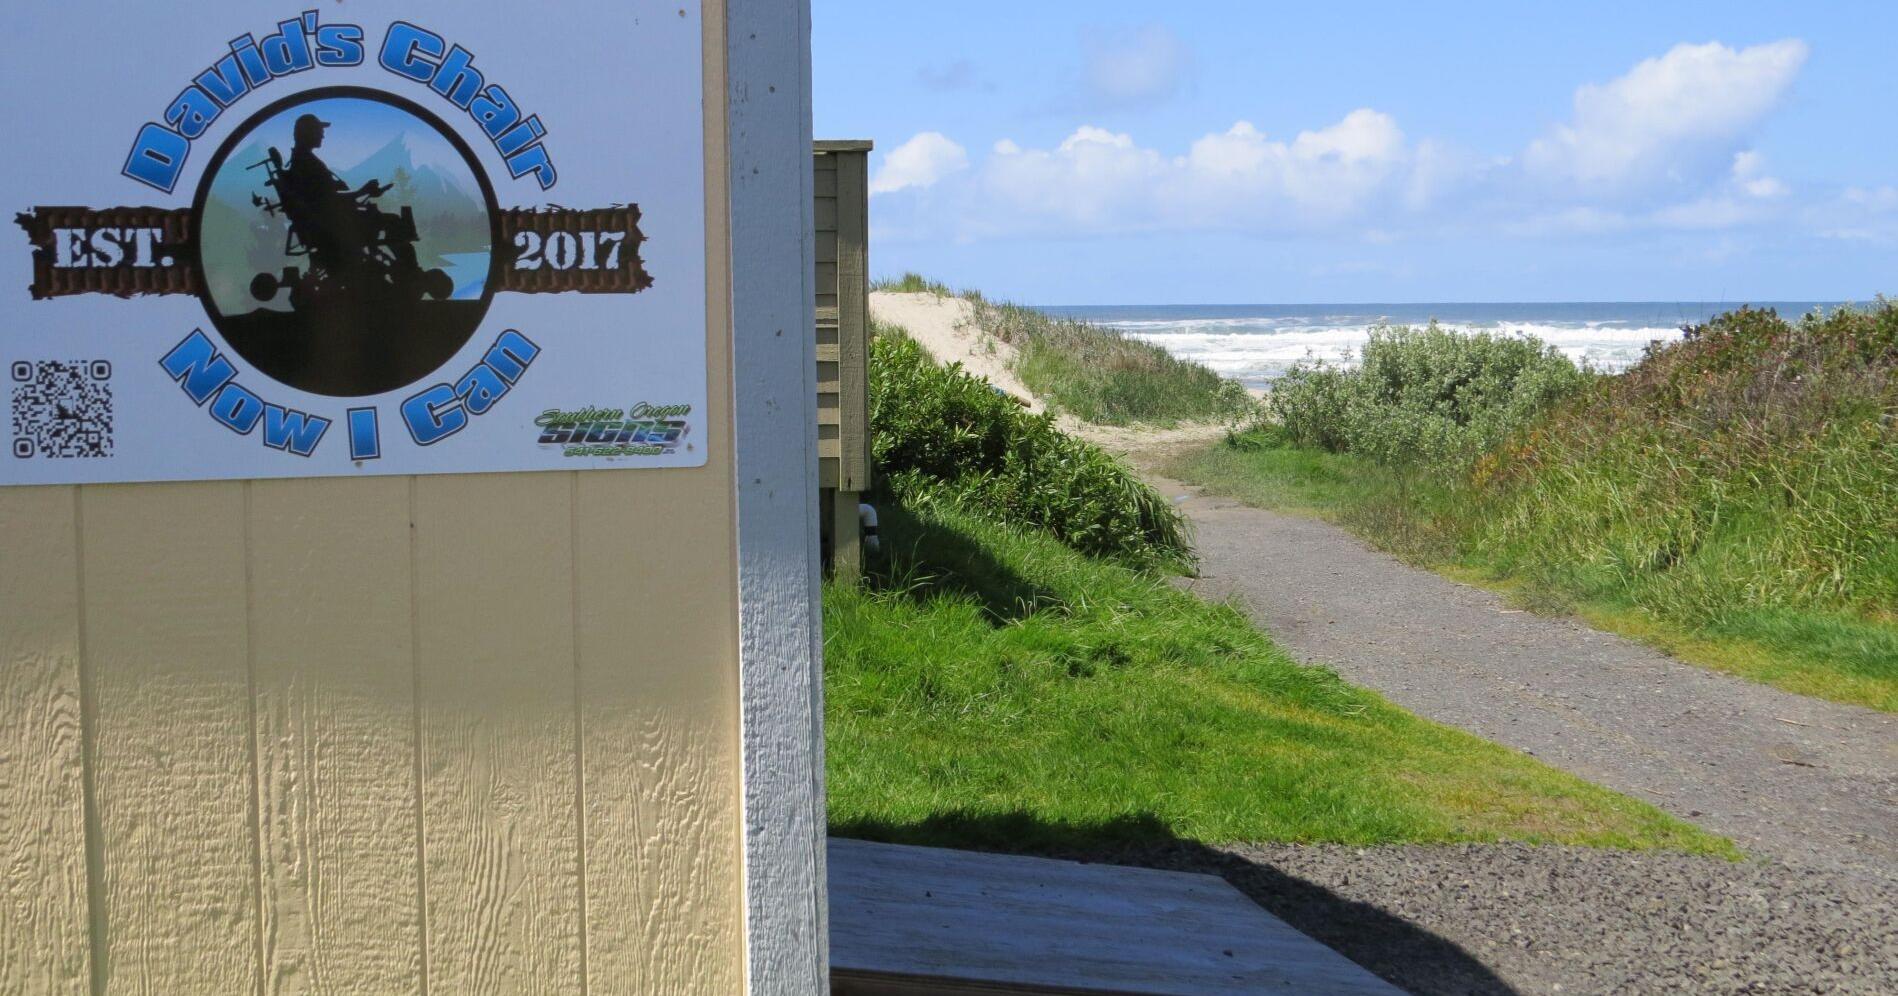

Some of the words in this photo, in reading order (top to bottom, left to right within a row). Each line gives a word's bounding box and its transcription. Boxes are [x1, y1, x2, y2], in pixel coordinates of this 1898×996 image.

[121, 9, 364, 194] David's
[378, 20, 557, 191] Chair
[52, 226, 174, 270] EST.
[513, 230, 626, 272] 2017
[158, 328, 331, 457] Now
[346, 406, 381, 460] I
[400, 328, 541, 447] Can
[534, 404, 624, 427] Southern
[629, 401, 692, 420] Oregon
